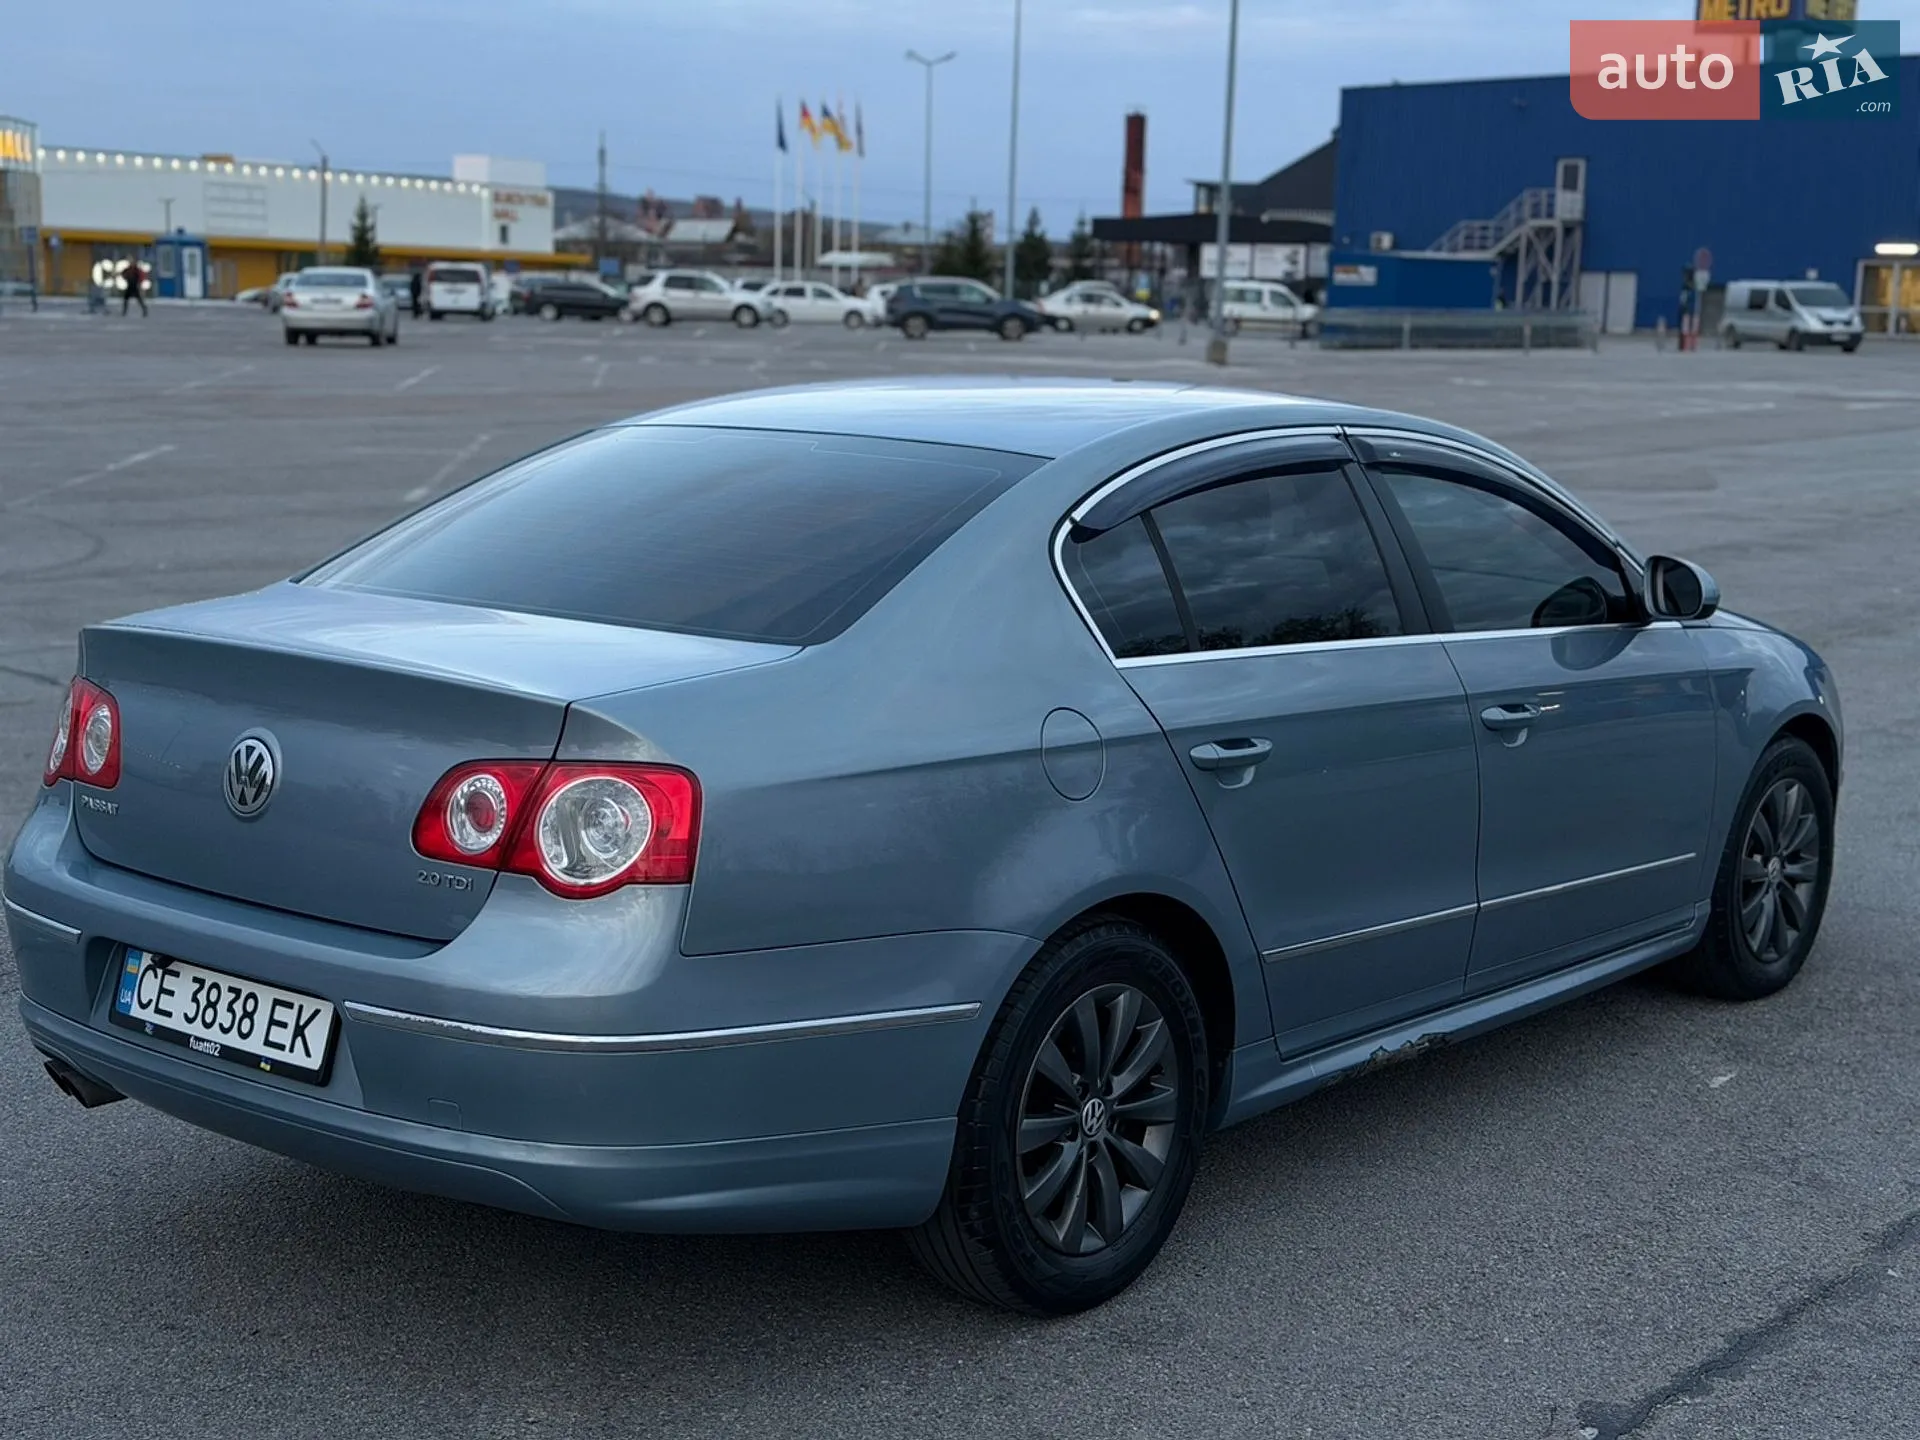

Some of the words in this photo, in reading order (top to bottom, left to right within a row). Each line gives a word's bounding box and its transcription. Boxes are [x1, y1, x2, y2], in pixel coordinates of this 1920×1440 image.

[0, 128, 32, 162] ALL
[119, 989, 132, 1005] UA
[137, 964, 180, 1018] CE
[184, 976, 259, 1040] 3838
[263, 998, 322, 1058] EK
